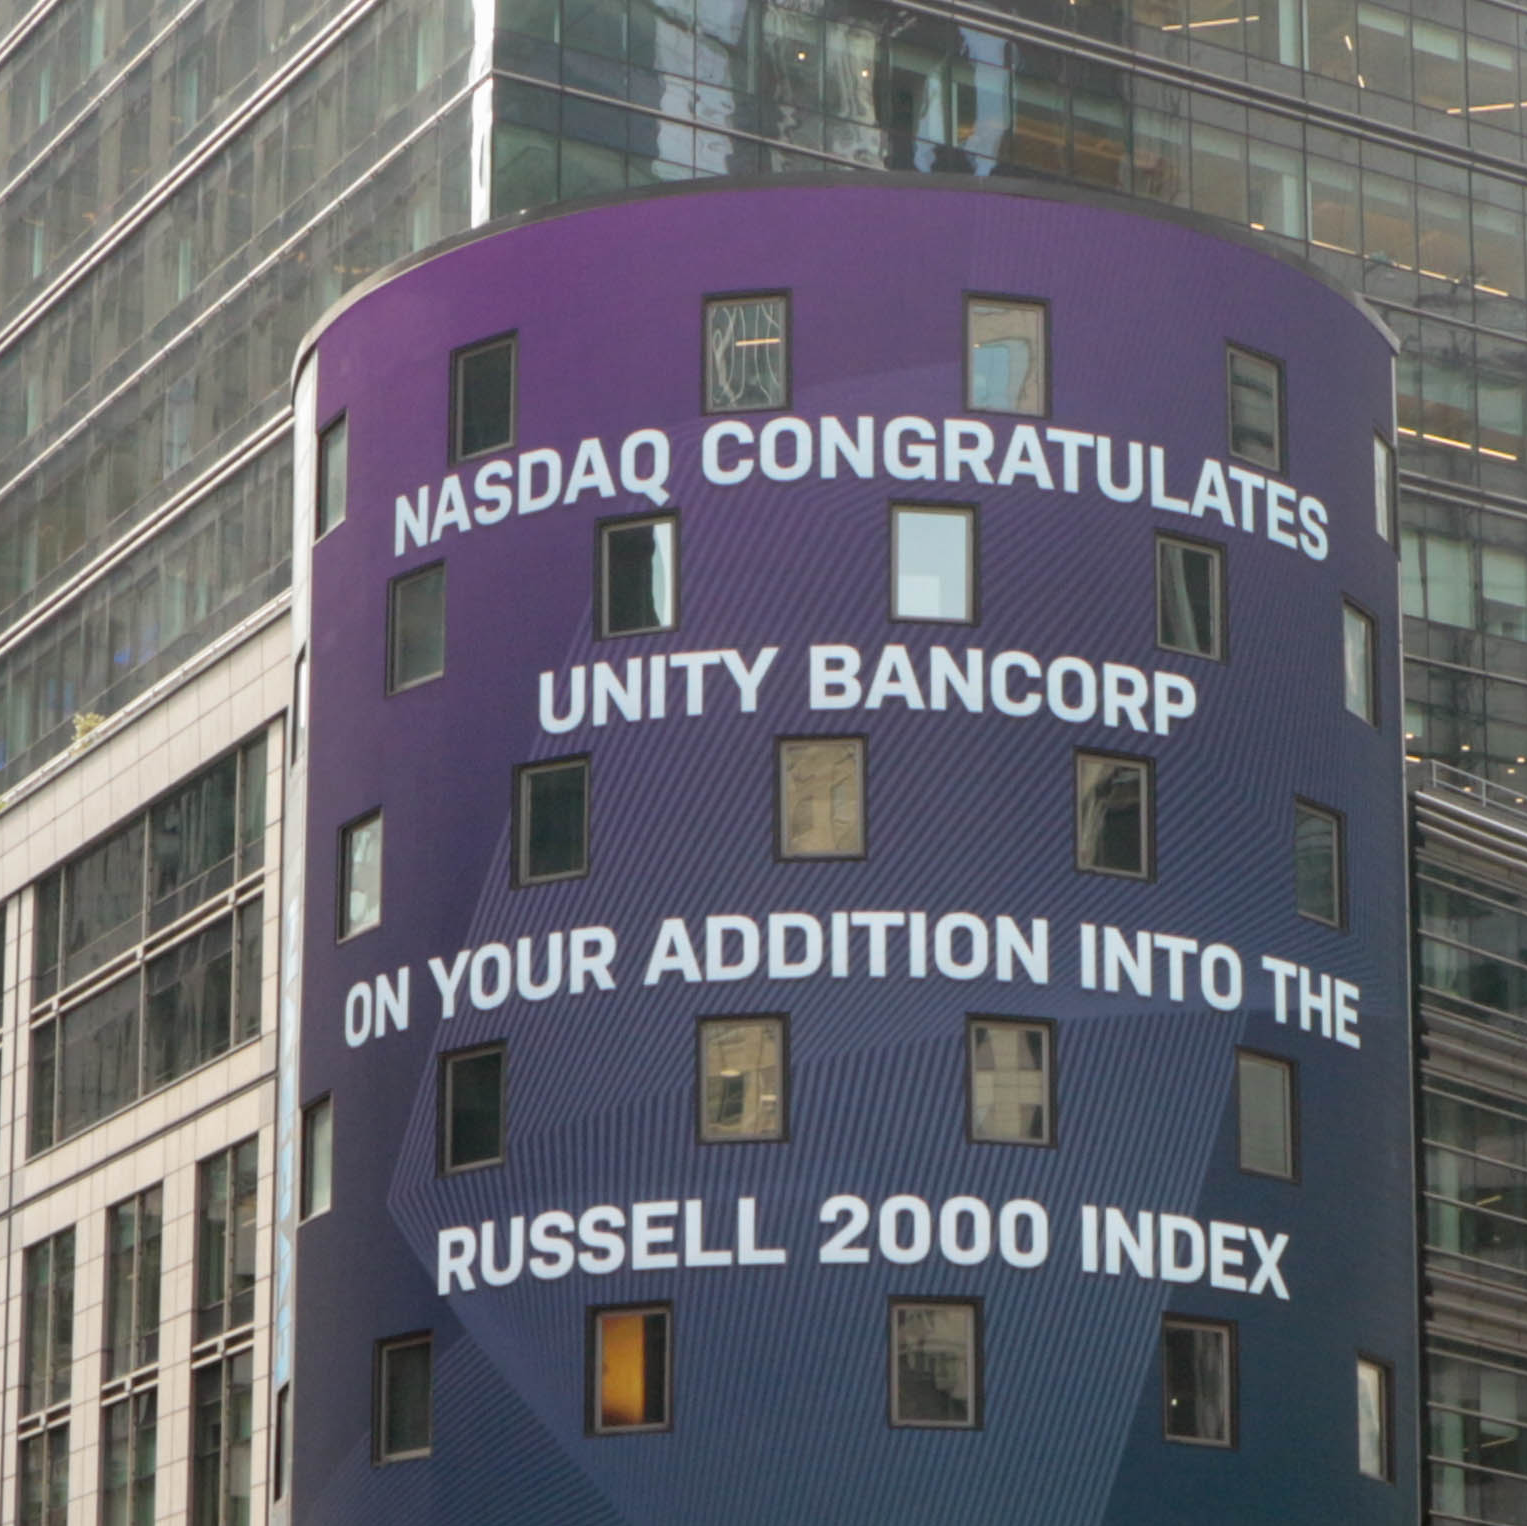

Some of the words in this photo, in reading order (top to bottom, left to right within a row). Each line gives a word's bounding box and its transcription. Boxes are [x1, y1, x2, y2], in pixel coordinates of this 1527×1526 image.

[394, 428, 671, 557] NASDAQ
[702, 415, 1329, 560] CONGRATULATES
[538, 646, 780, 735] UNITY
[808, 644, 1197, 737] BANCORP
[344, 966, 411, 1049] ON
[429, 926, 616, 1020] YOUR
[643, 910, 1051, 986] ADDITION
[1080, 924, 1243, 1012] INTO
[1262, 956, 1362, 1050] THE
[437, 1197, 786, 1295] RUSSELL
[818, 1193, 1050, 1268] 2000
[1080, 1204, 1291, 1300] INDEX
